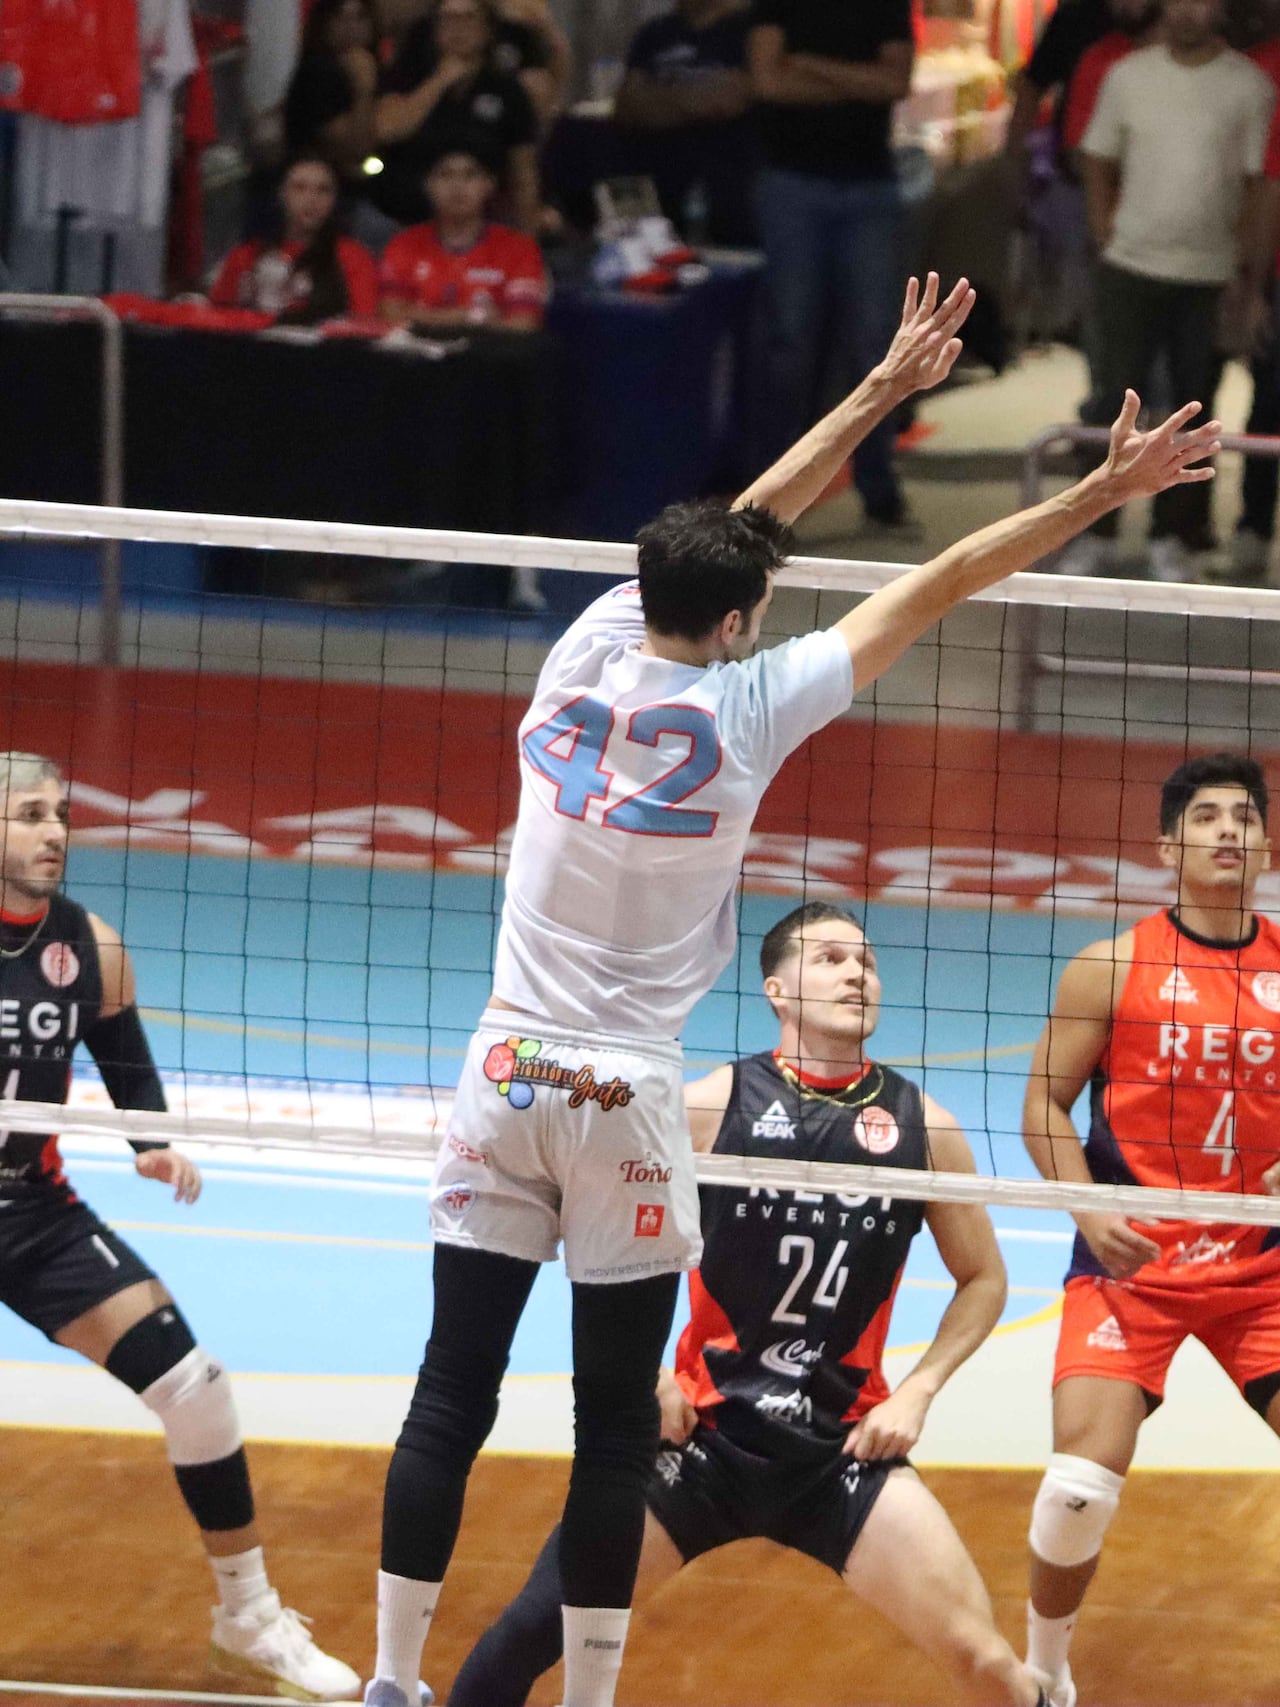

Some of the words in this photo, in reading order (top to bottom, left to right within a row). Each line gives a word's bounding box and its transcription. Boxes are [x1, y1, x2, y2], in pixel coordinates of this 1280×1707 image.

[522, 694, 722, 838] 42
[0, 1000, 79, 1040] EGI
[752, 1121, 798, 1140] PEAK
[1202, 1091, 1238, 1176] 4
[736, 1203, 896, 1234] EVENTOS
[771, 1234, 850, 1325] 24
